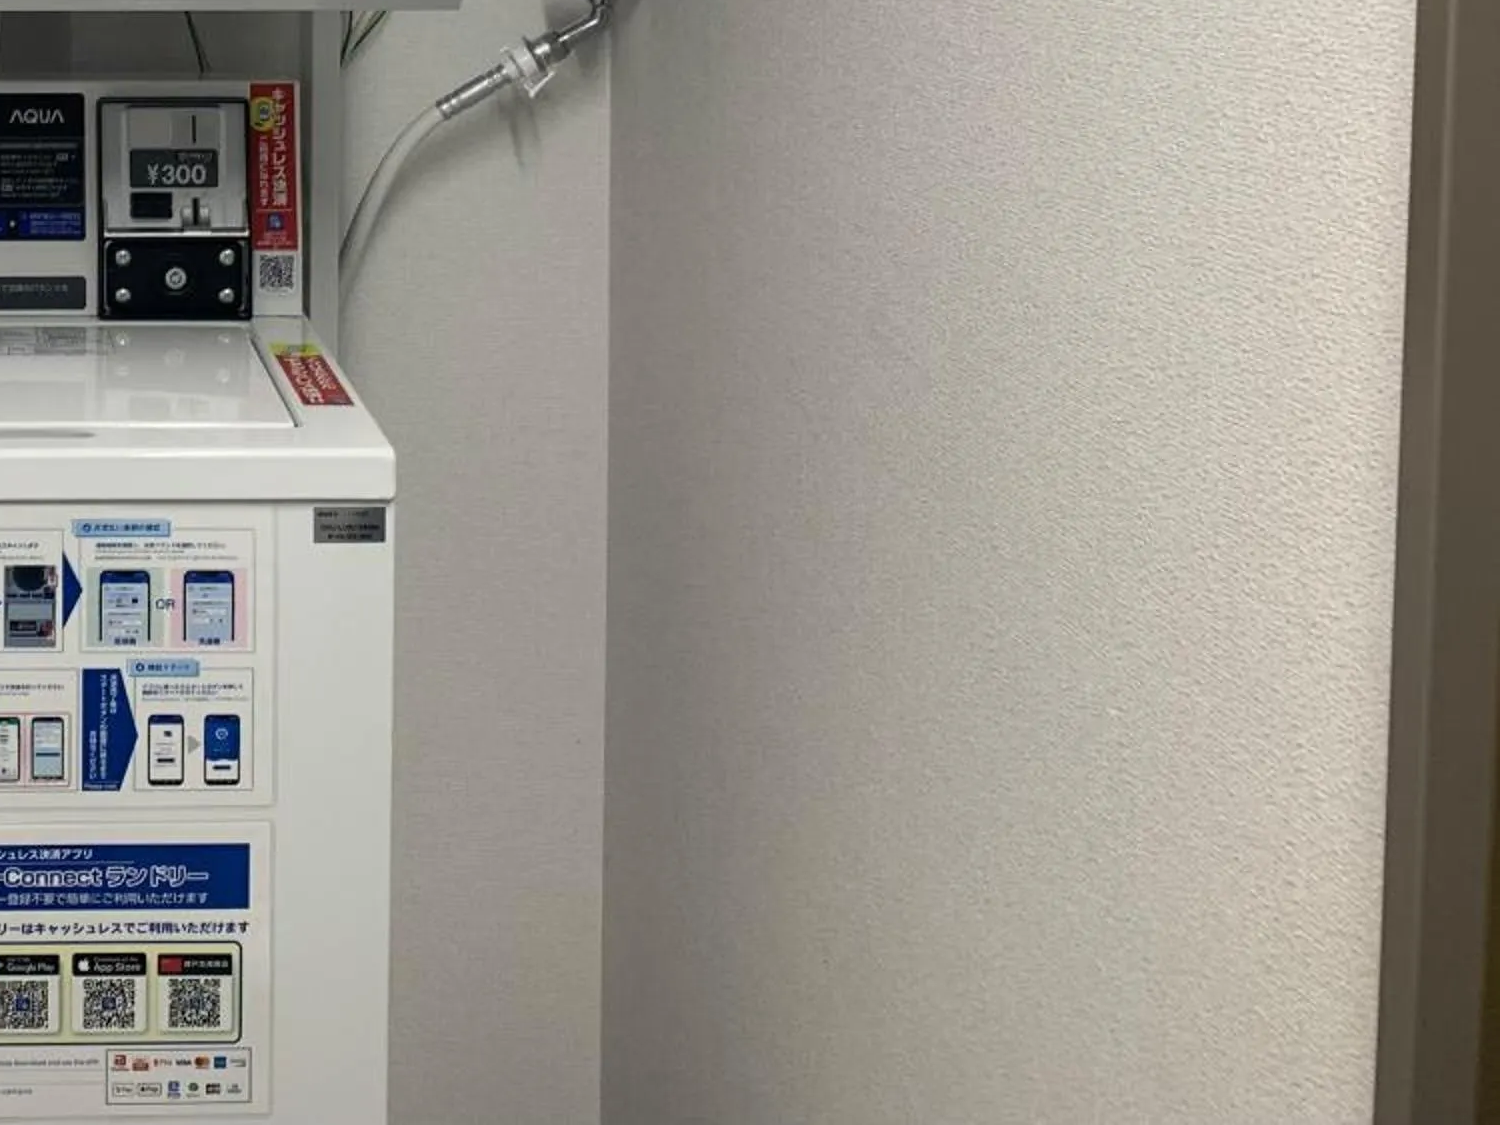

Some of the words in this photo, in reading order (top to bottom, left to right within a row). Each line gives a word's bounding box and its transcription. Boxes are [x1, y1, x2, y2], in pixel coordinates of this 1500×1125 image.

[8, 108, 65, 124] AQUA
[147, 163, 207, 185] ¥300
[155, 598, 175, 610] OR
[105, 867, 210, 889] ランドリー
[6, 962, 36, 974] Google
[37, 962, 56, 974] Play
[93, 961, 113, 973] App
[115, 961, 141, 972] Store
